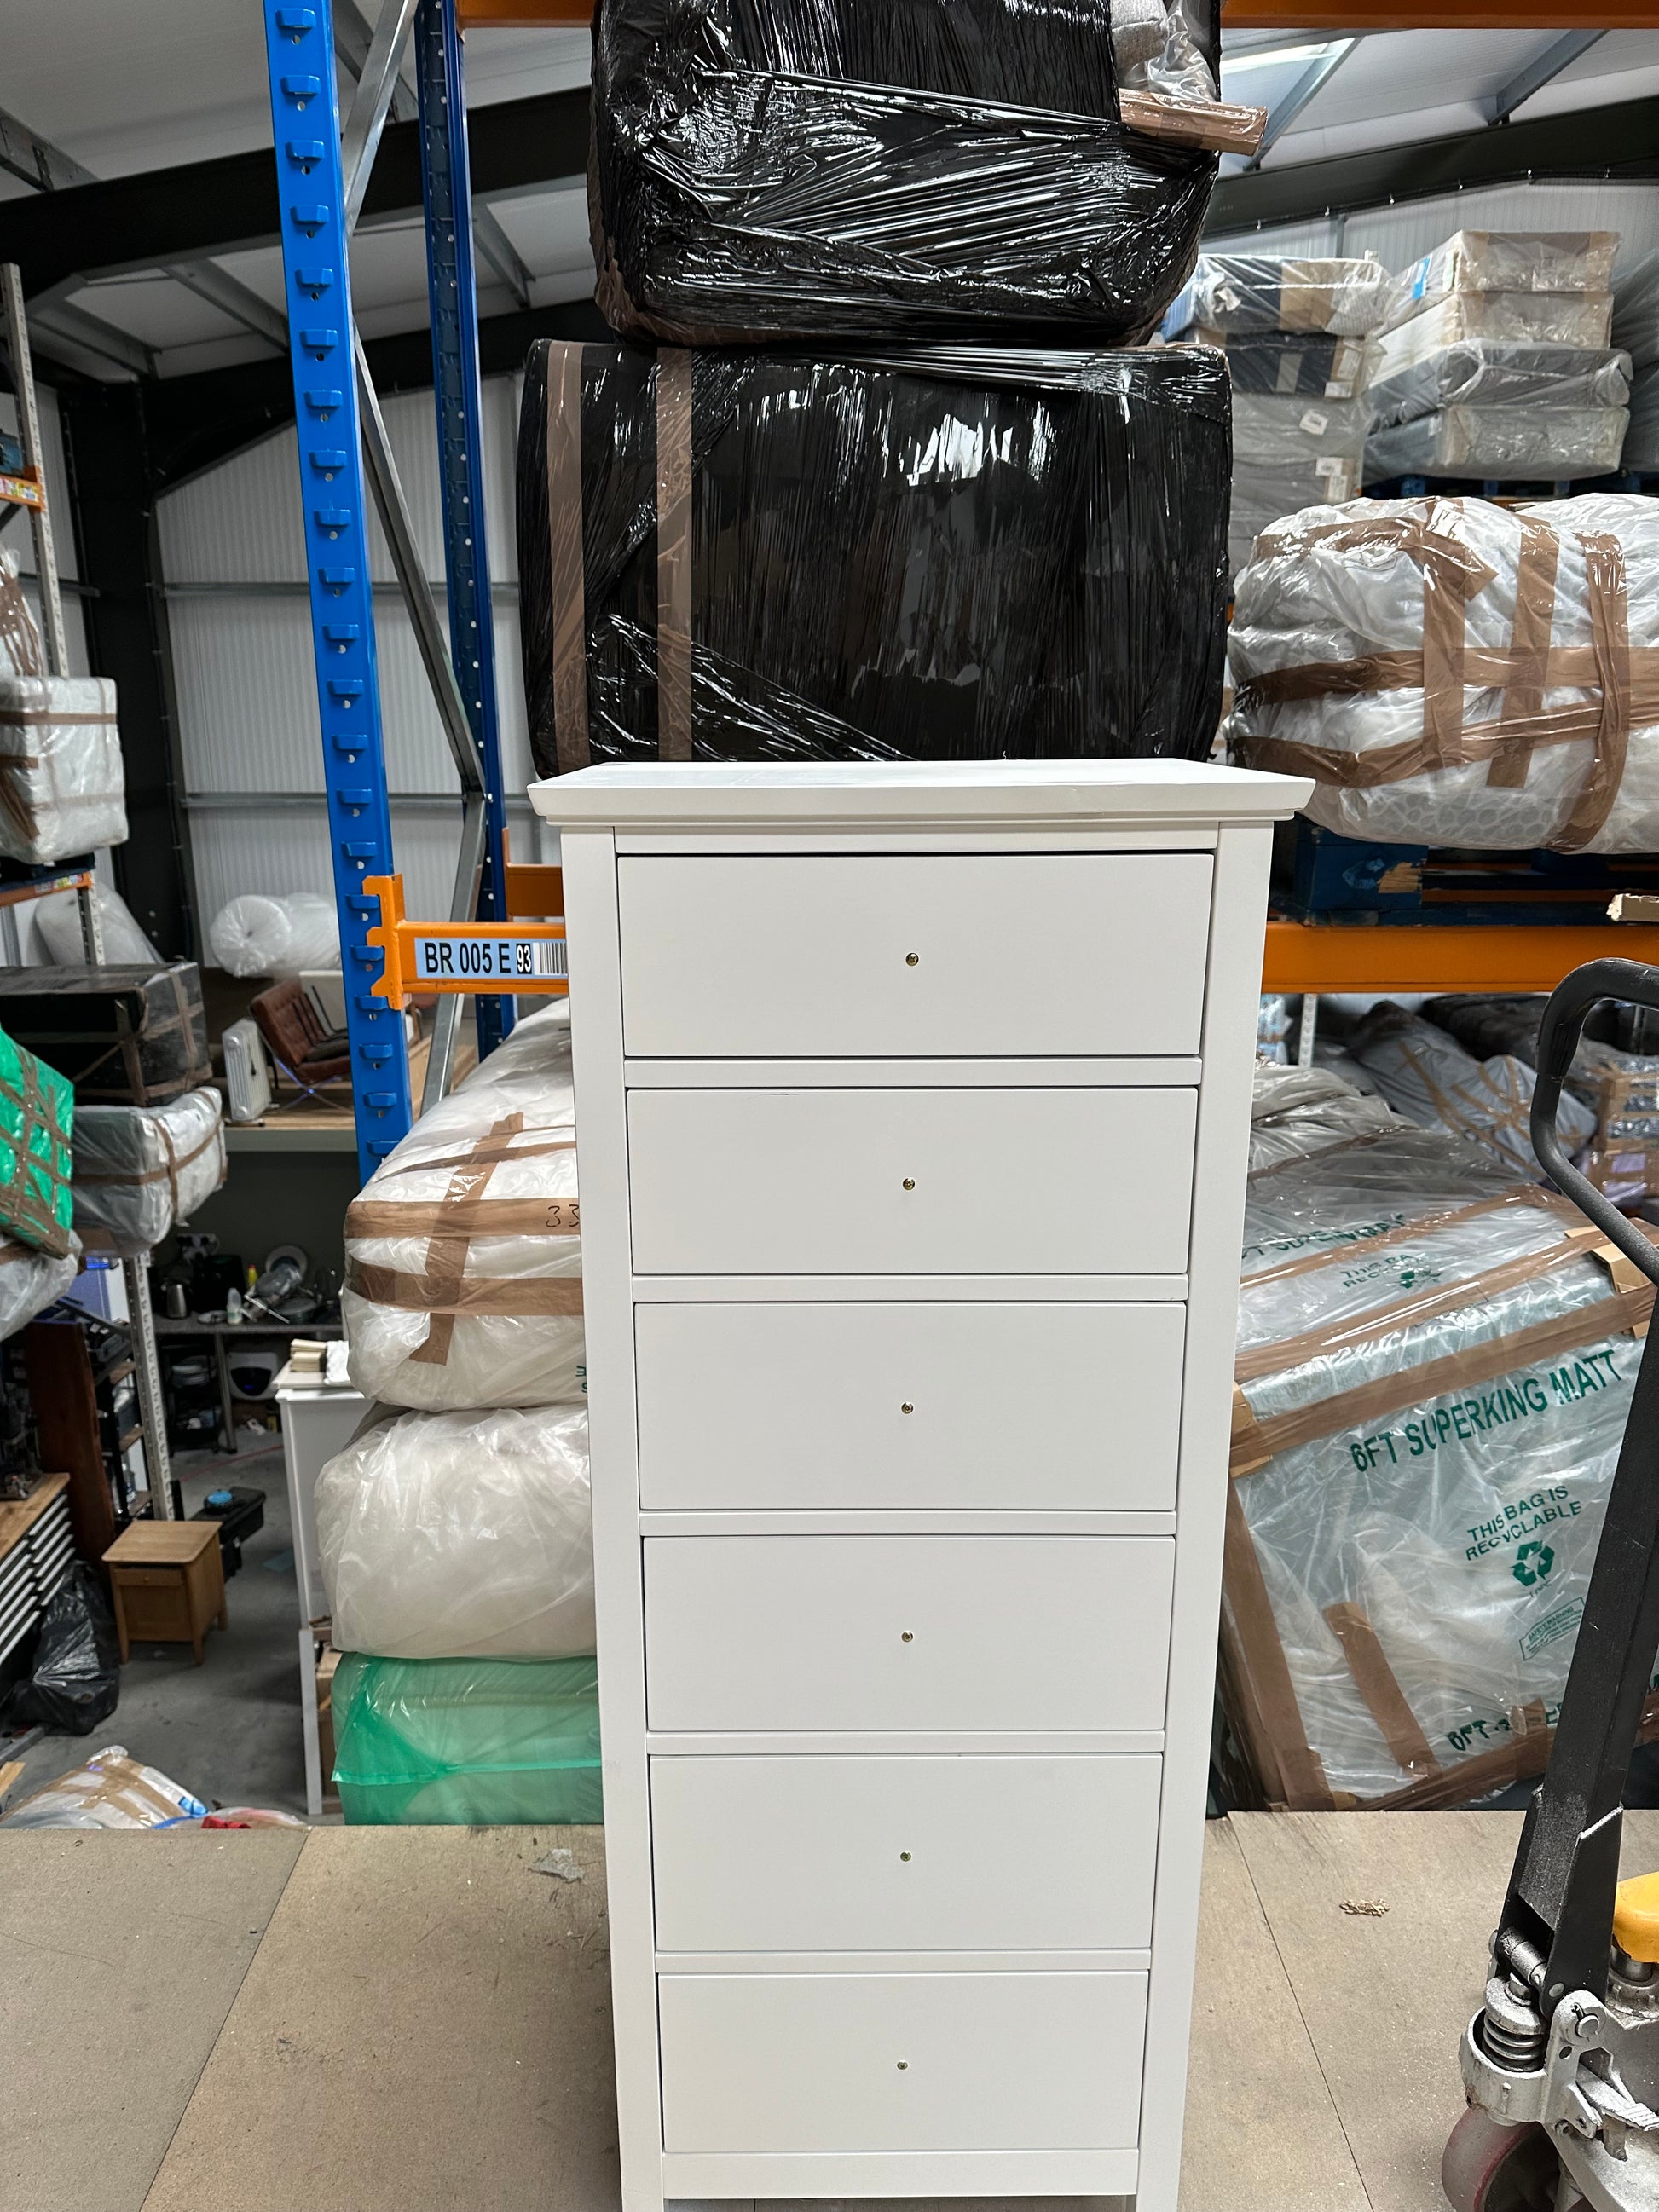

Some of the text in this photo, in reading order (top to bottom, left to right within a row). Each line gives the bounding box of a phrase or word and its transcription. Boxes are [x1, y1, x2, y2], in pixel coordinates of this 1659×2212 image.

[425, 942, 532, 974] BR 005 E 93
[1350, 1349, 1622, 1473] 6FT SUPERKING MATT
[1465, 1500, 1582, 1561] RECYCLABLE
[1467, 1485, 1569, 1542] THIS BAG IS
